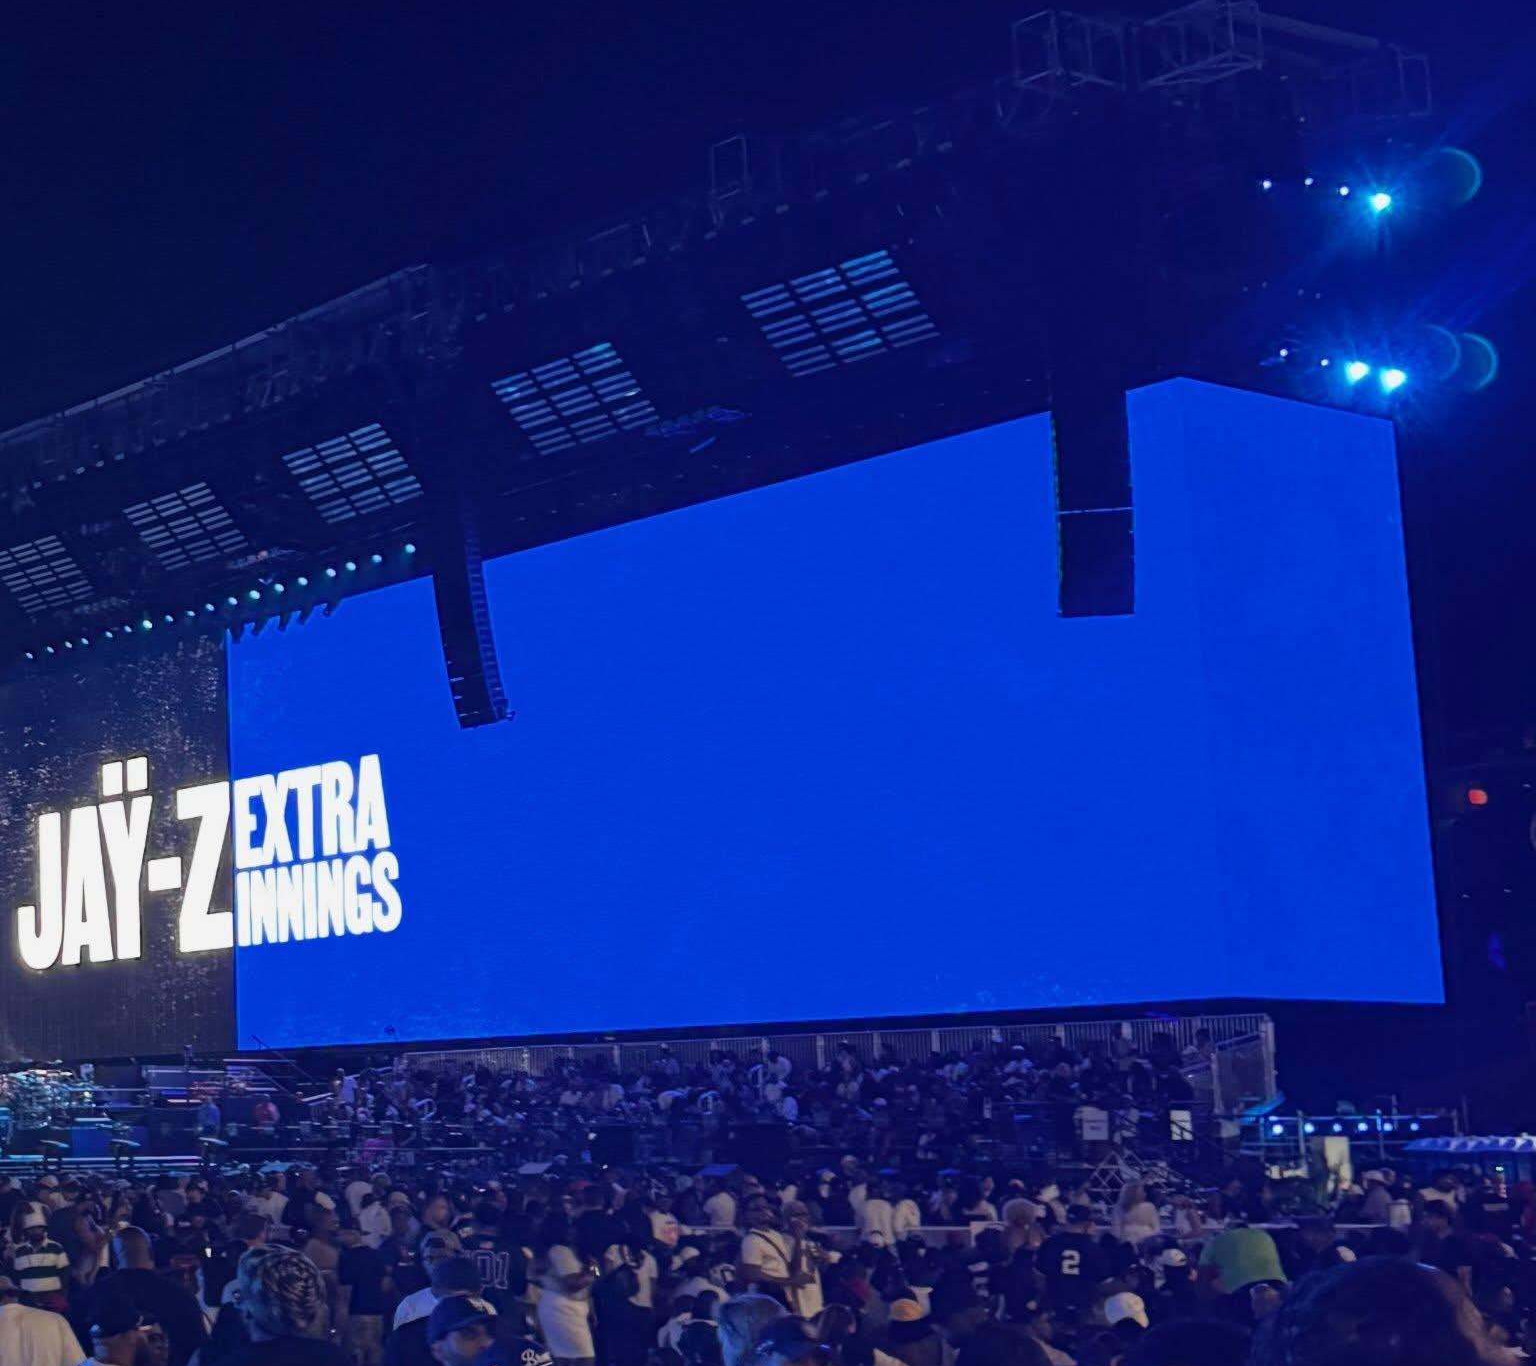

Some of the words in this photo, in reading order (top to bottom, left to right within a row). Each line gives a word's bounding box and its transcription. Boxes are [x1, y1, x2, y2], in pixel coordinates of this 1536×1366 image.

[17, 756, 233, 970] JAŸ-Z
[233, 754, 391, 870] EXTRA
[236, 851, 403, 947] INNINGS
[1061, 1249, 1081, 1275] 2
